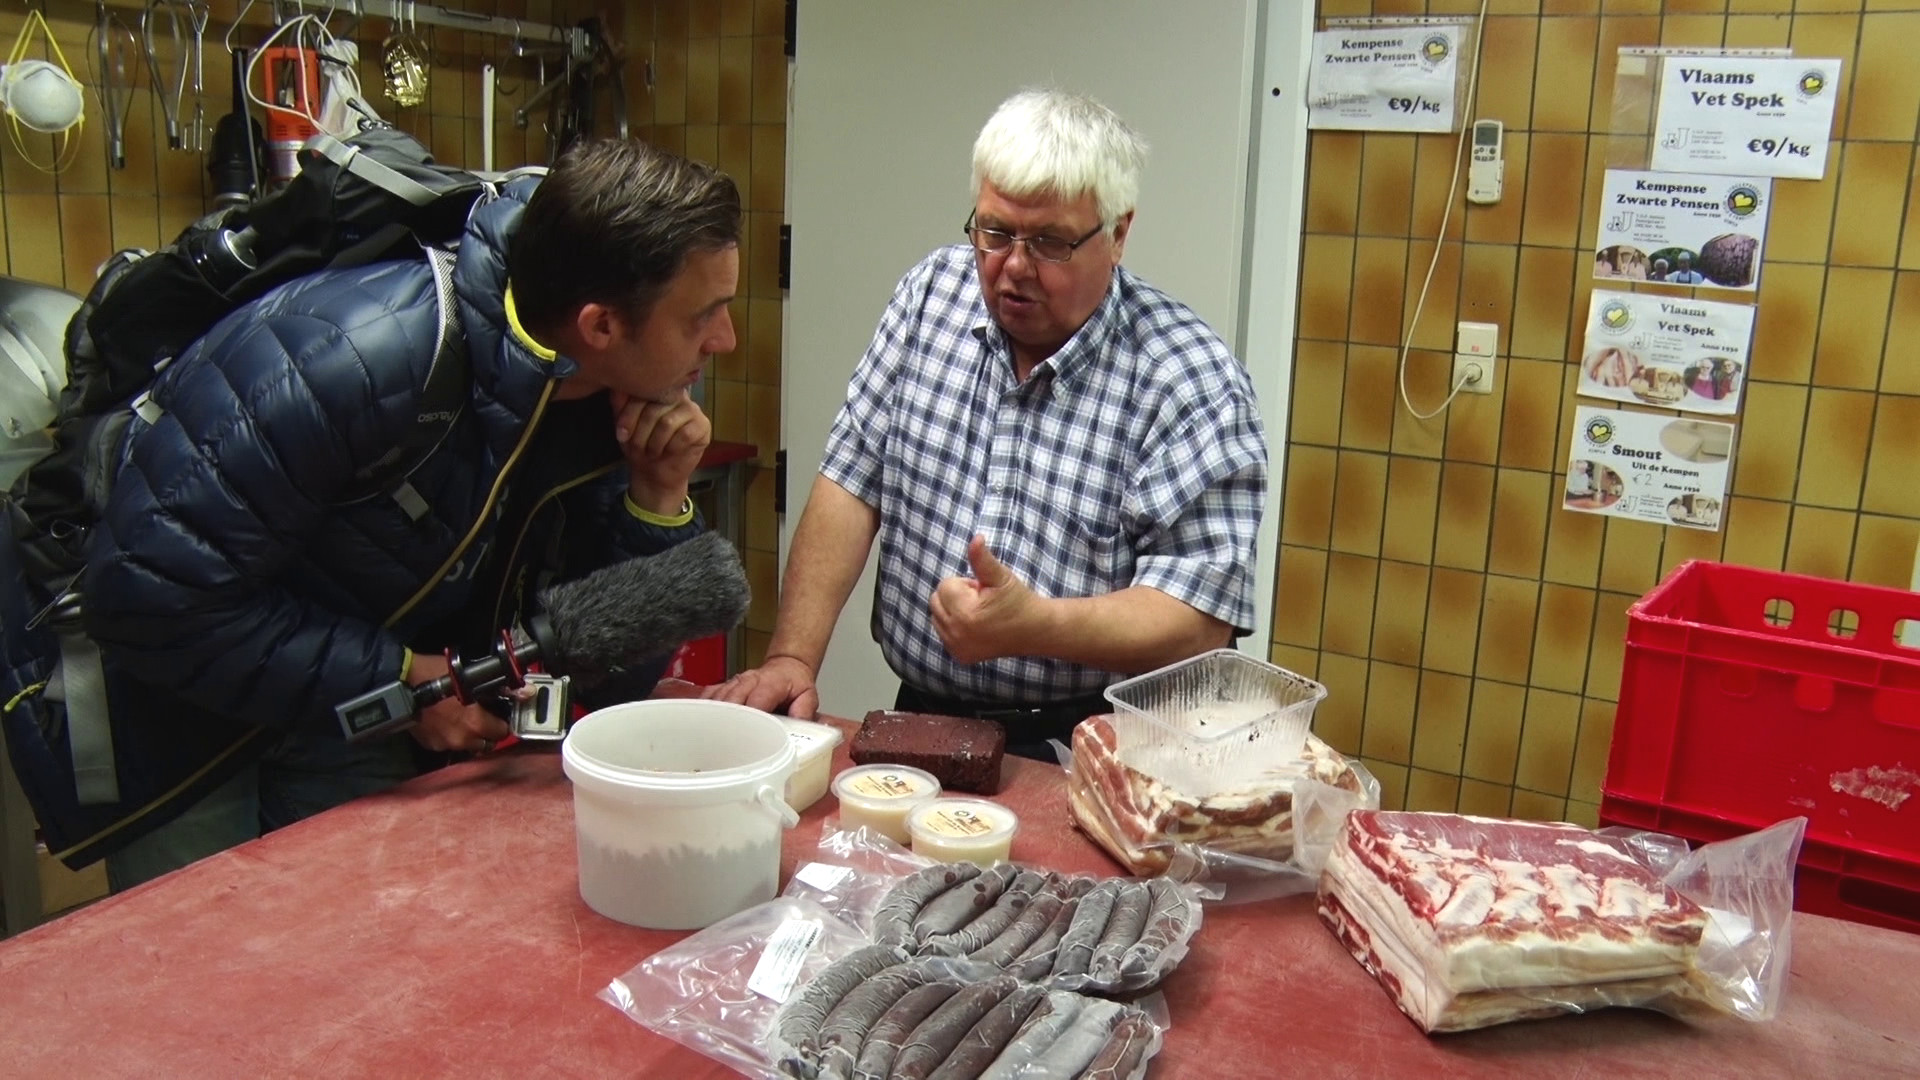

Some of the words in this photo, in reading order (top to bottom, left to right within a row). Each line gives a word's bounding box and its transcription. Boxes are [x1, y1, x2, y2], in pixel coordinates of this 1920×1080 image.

[1341, 38, 1404, 50] Kempense
[1325, 54, 1370, 64] Zwarte
[1373, 52, 1416, 62] Pensen
[1680, 69, 1754, 84] Vlaams
[1388, 95, 1441, 115] €9/kg
[1691, 91, 1726, 106] Vet
[1731, 92, 1785, 110] Spek
[1747, 137, 1811, 158] €9/kg
[1636, 180, 1707, 194] Kempense
[1616, 194, 1667, 207] Zwarte
[1671, 197, 1719, 210] Pensen
[1661, 303, 1707, 318] Vlaams
[1658, 321, 1679, 332] Vet
[1682, 323, 1715, 337] Spek
[1612, 444, 1662, 460] Smout
[1632, 461, 1647, 470] Uit
[1648, 464, 1660, 472] de
[1661, 466, 1699, 477] Kempen
[1663, 482, 1682, 491] Anno
